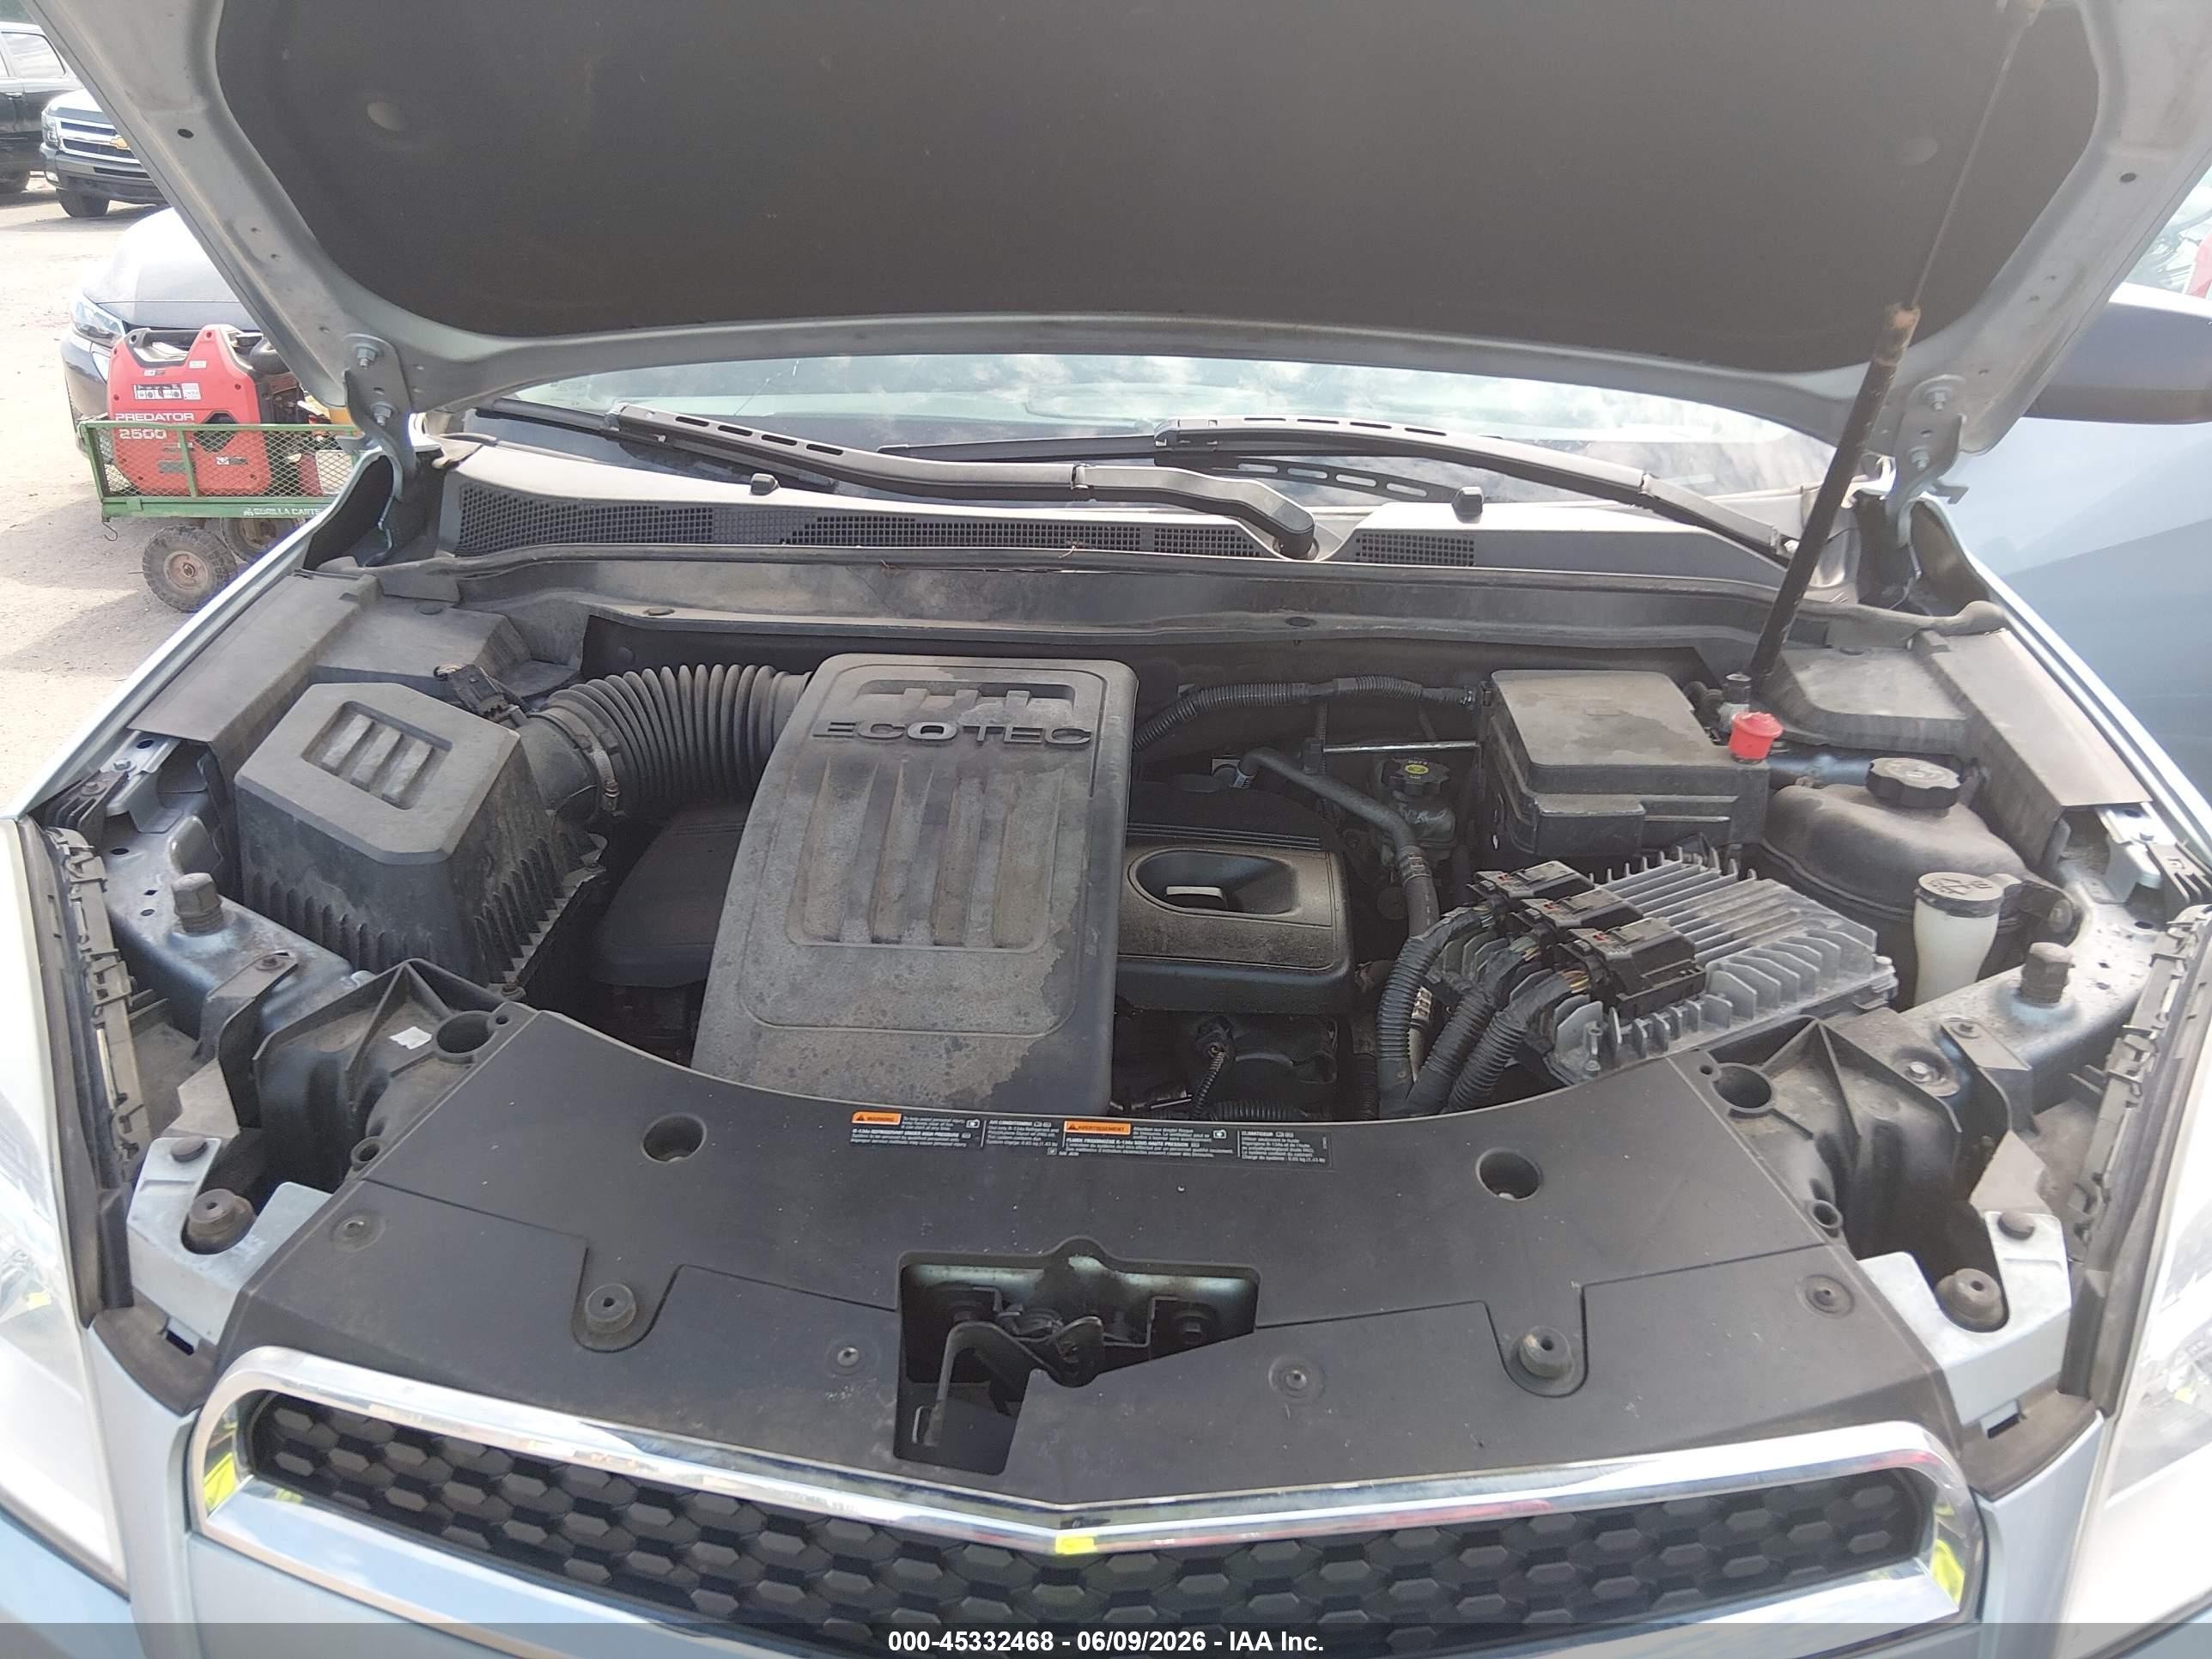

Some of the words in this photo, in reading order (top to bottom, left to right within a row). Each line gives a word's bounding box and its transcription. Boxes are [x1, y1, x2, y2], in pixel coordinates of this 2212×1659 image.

[115, 412, 195, 422] PREDATOR
[118, 428, 167, 440] 2500
[812, 720, 1092, 746] ECOTEC
